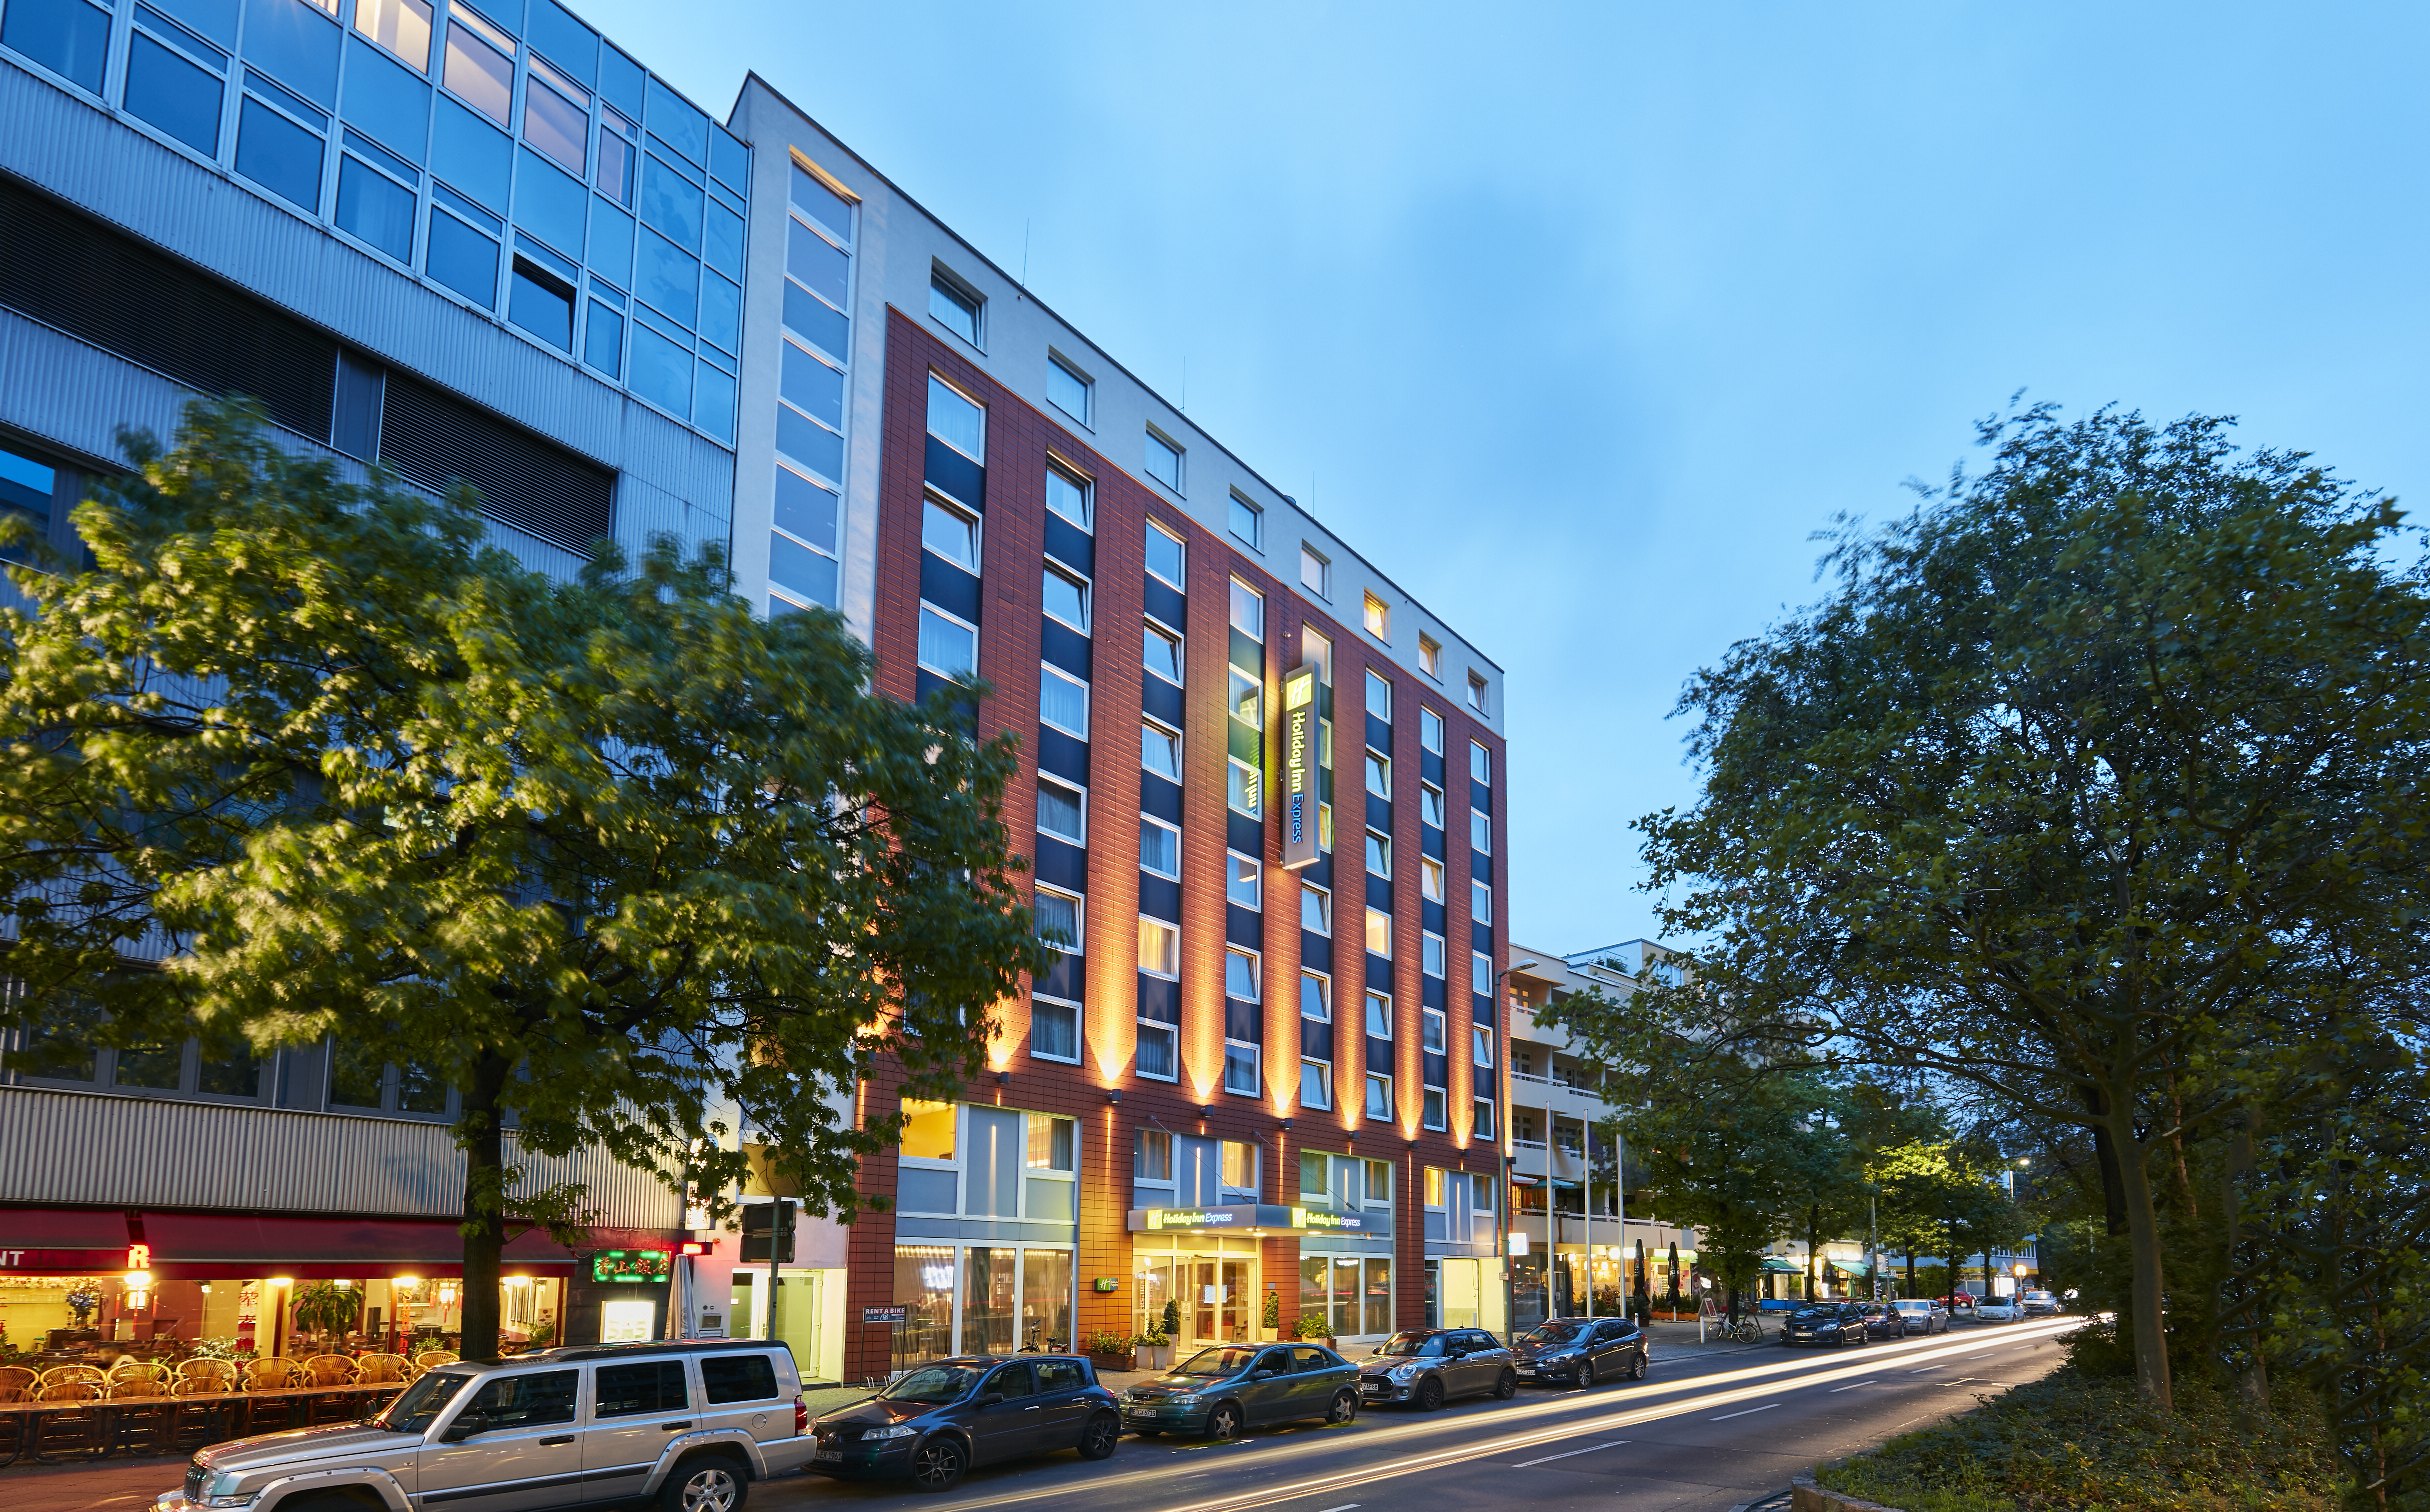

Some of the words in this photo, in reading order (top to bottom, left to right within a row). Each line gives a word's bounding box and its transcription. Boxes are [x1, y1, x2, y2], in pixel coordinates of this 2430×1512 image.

[1289, 711, 1306, 768] Holiday
[1292, 768, 1306, 793] Inn
[1290, 793, 1304, 844] Express
[1163, 1212, 1192, 1225] Holiday
[1192, 1212, 1205, 1222] Inn
[1205, 1212, 1232, 1224] Express
[1306, 1213, 1331, 1226] Holiday
[1331, 1214, 1341, 1225] Inn
[1341, 1216, 1361, 1228] Express
[828, 1452, 841, 1460] 1961
